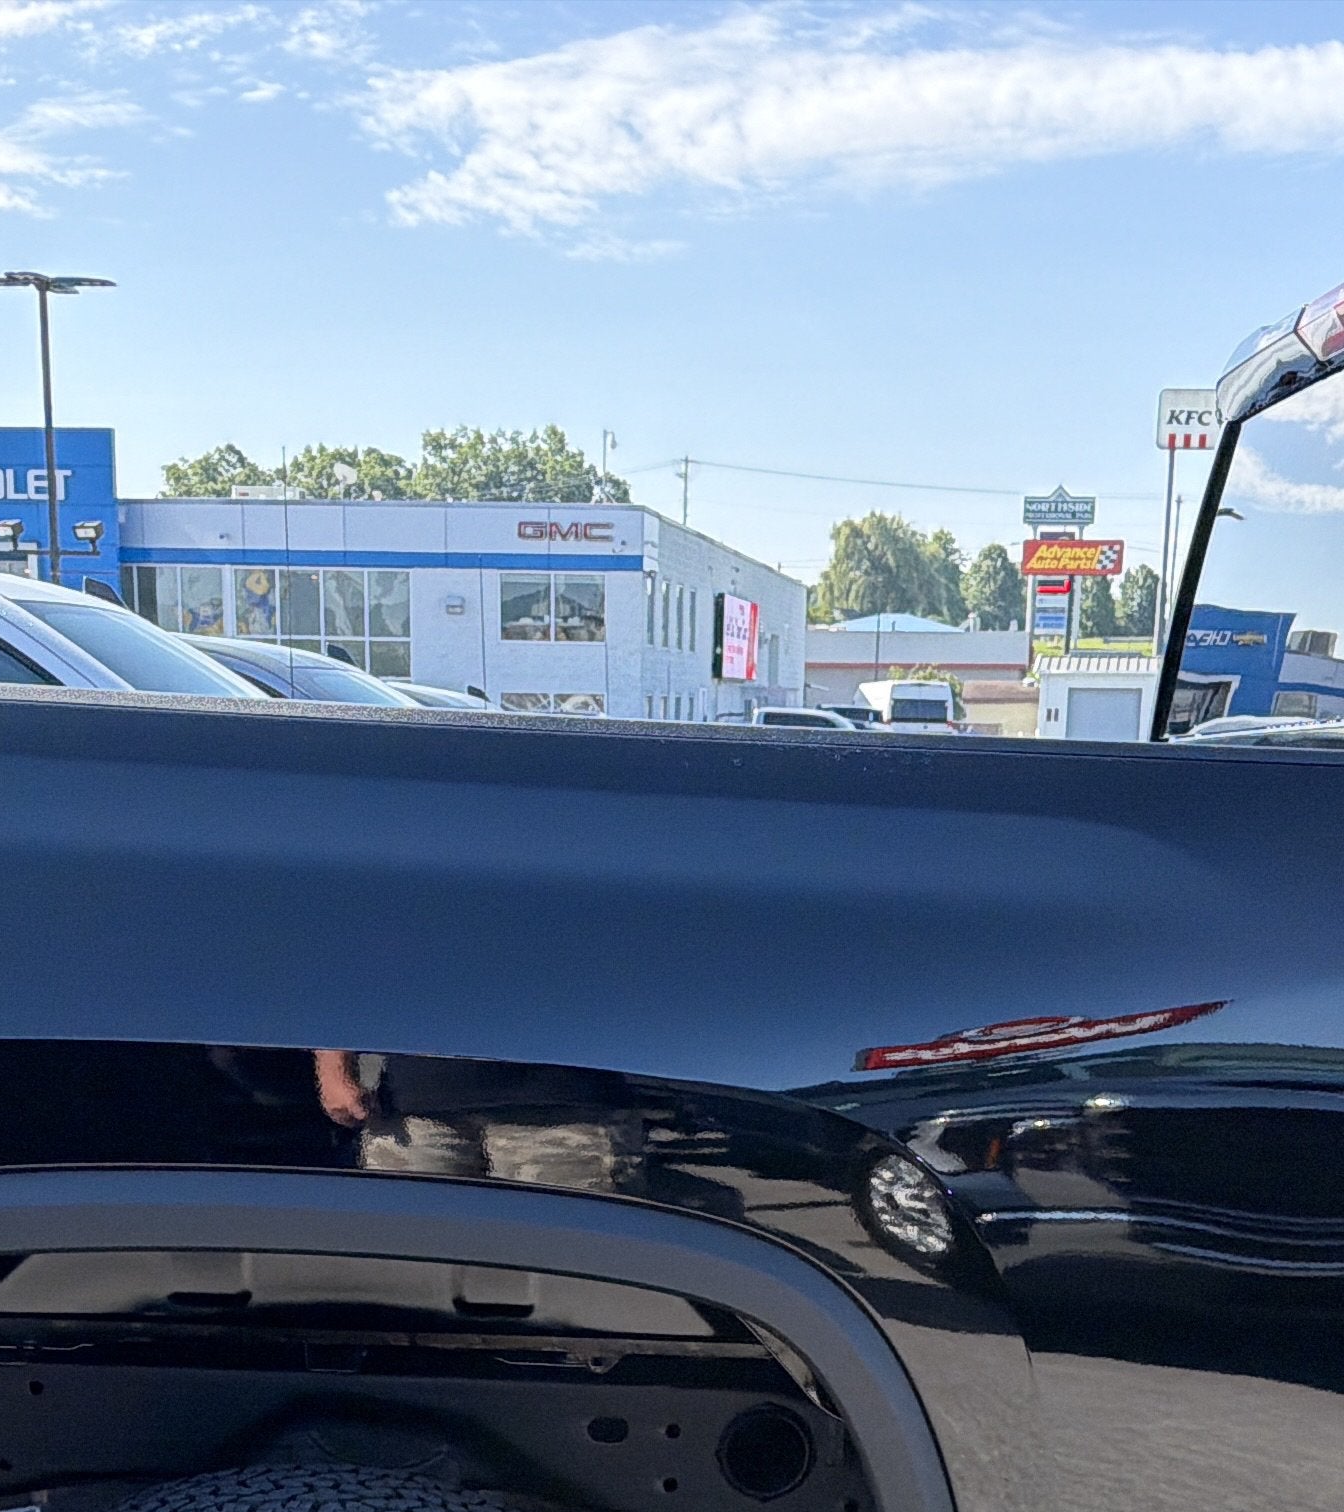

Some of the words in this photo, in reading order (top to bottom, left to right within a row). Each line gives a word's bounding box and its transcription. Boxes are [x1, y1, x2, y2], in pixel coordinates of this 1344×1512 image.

[1166, 409, 1212, 427] KFC
[1025, 502, 1093, 513] NORTHSIDE
[518, 521, 615, 542] GMC
[1034, 544, 1096, 559] Advance
[1026, 558, 1057, 570] Auto
[1057, 558, 1092, 570] Parts
